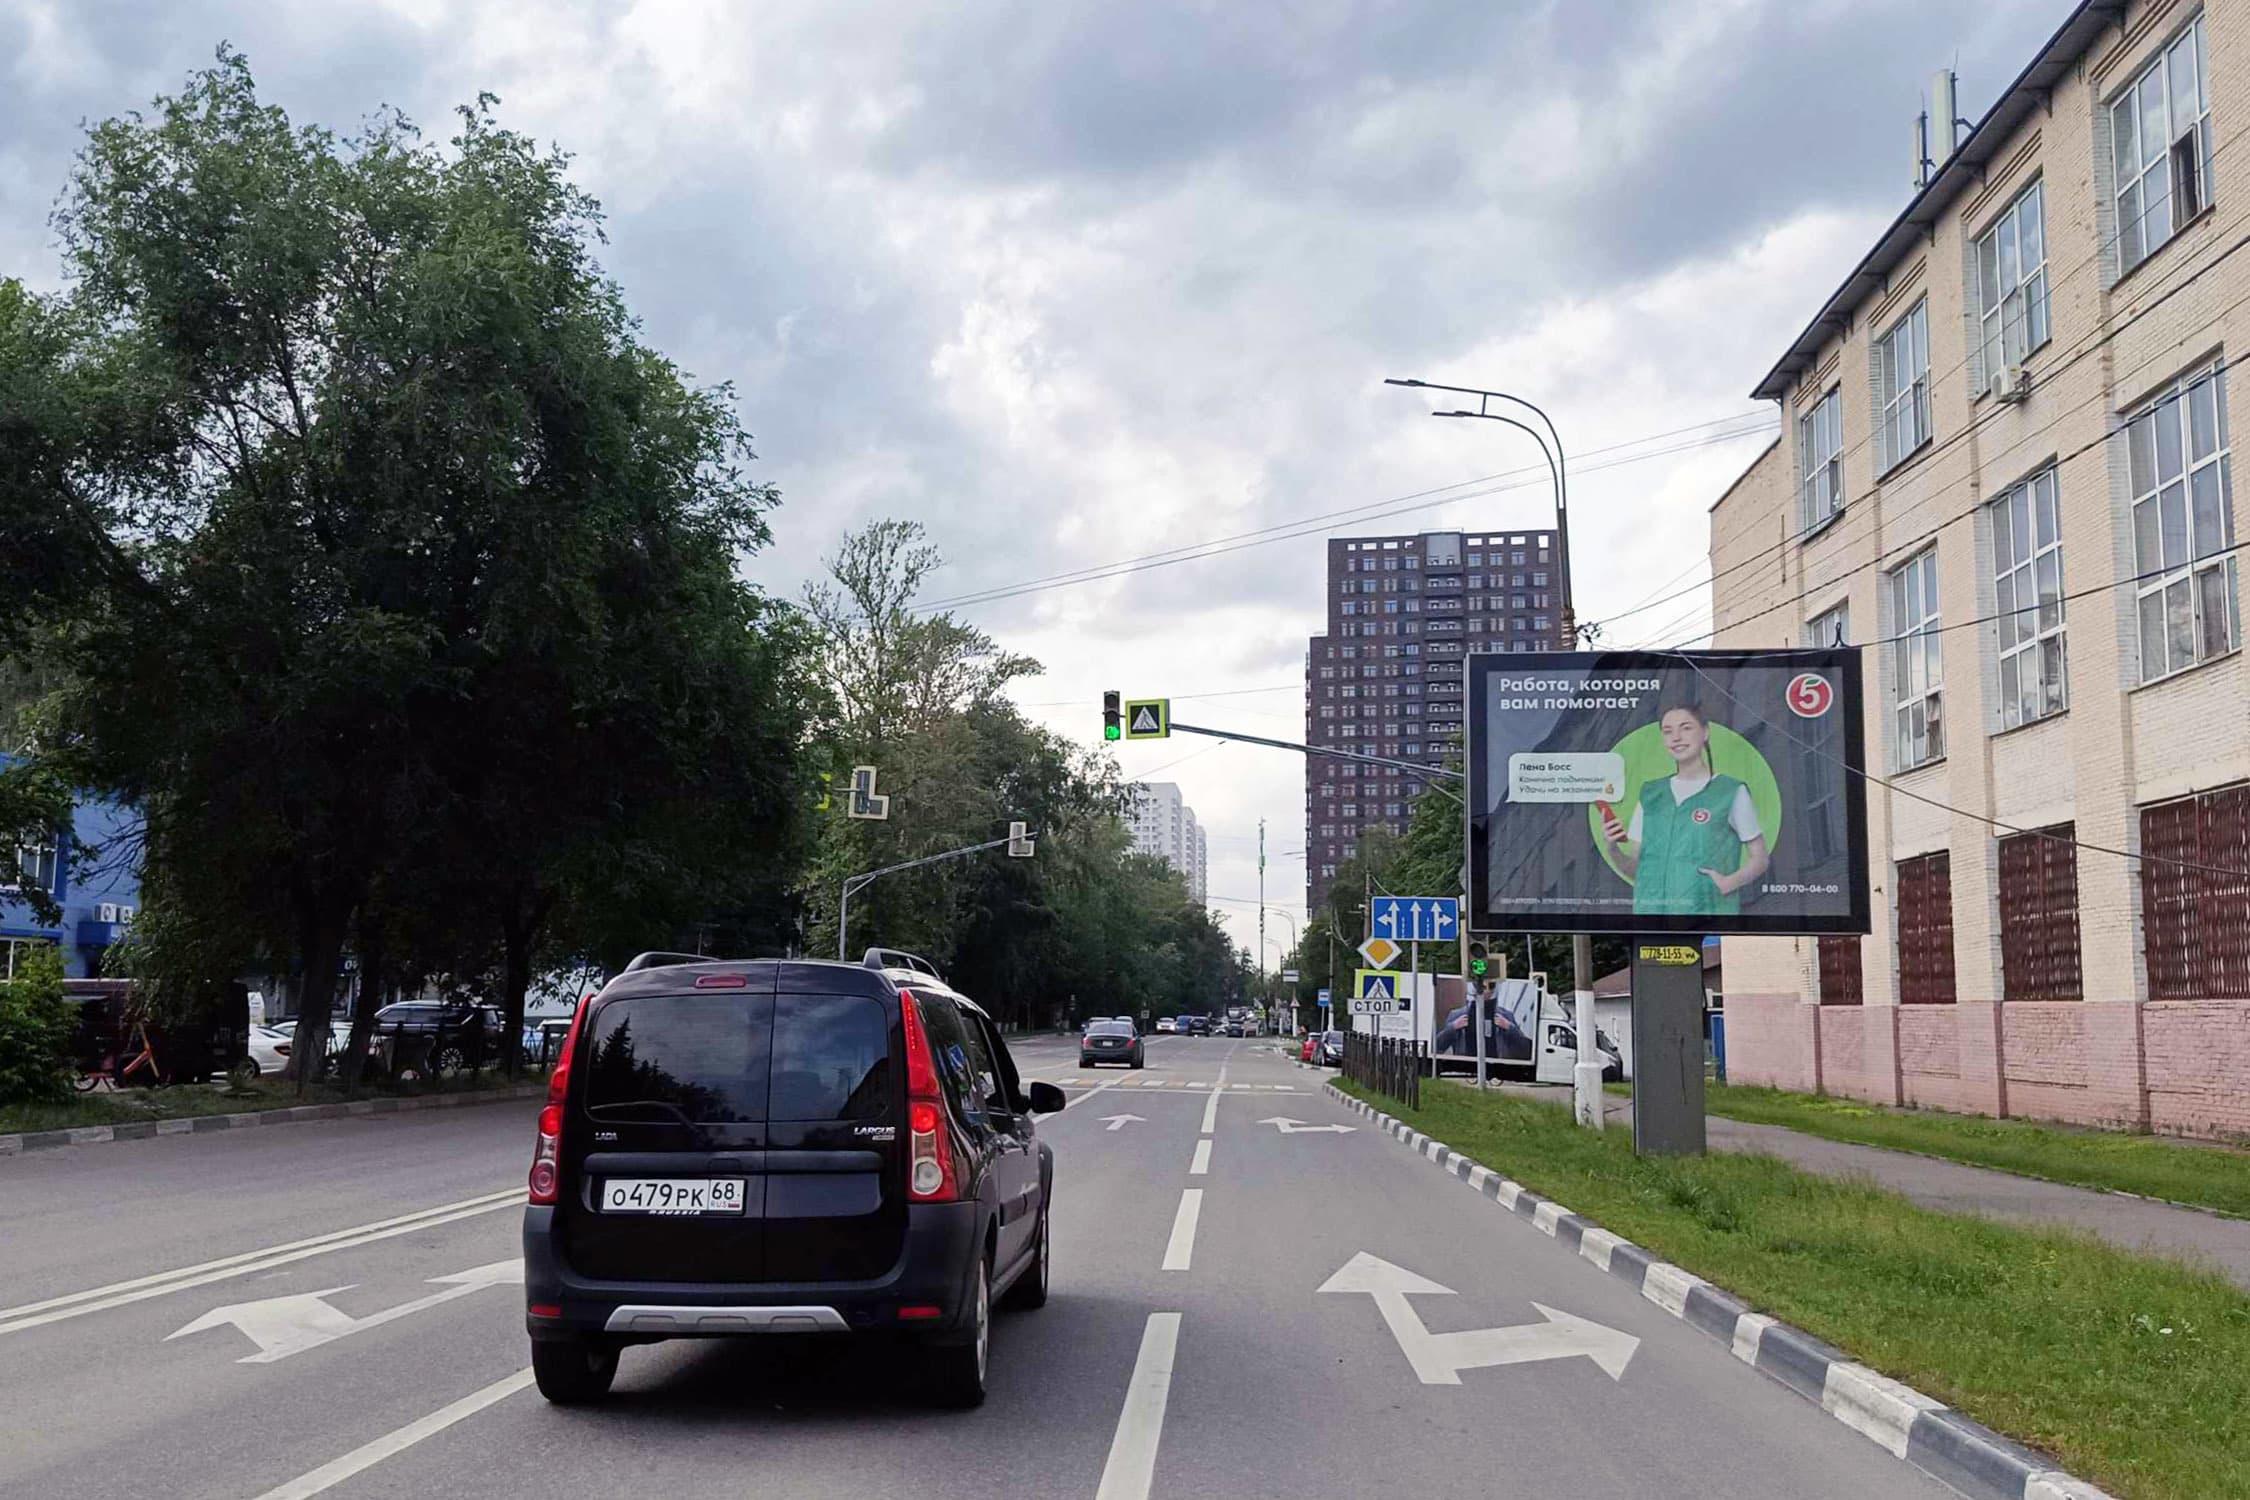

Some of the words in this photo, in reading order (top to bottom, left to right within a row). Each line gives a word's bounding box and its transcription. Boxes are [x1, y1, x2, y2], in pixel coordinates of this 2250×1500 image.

[1500, 677, 1574, 693] Работа,
[1580, 679, 1660, 694] которая
[1500, 698, 1538, 709] вам
[1544, 697, 1639, 709] помогает
[1548, 763, 1572, 771] Босс
[1354, 1001, 1392, 1012] СТОП
[595, 1131, 618, 1140] LADA
[854, 1127, 895, 1135] LARGUS
[711, 1182, 735, 1200] 68
